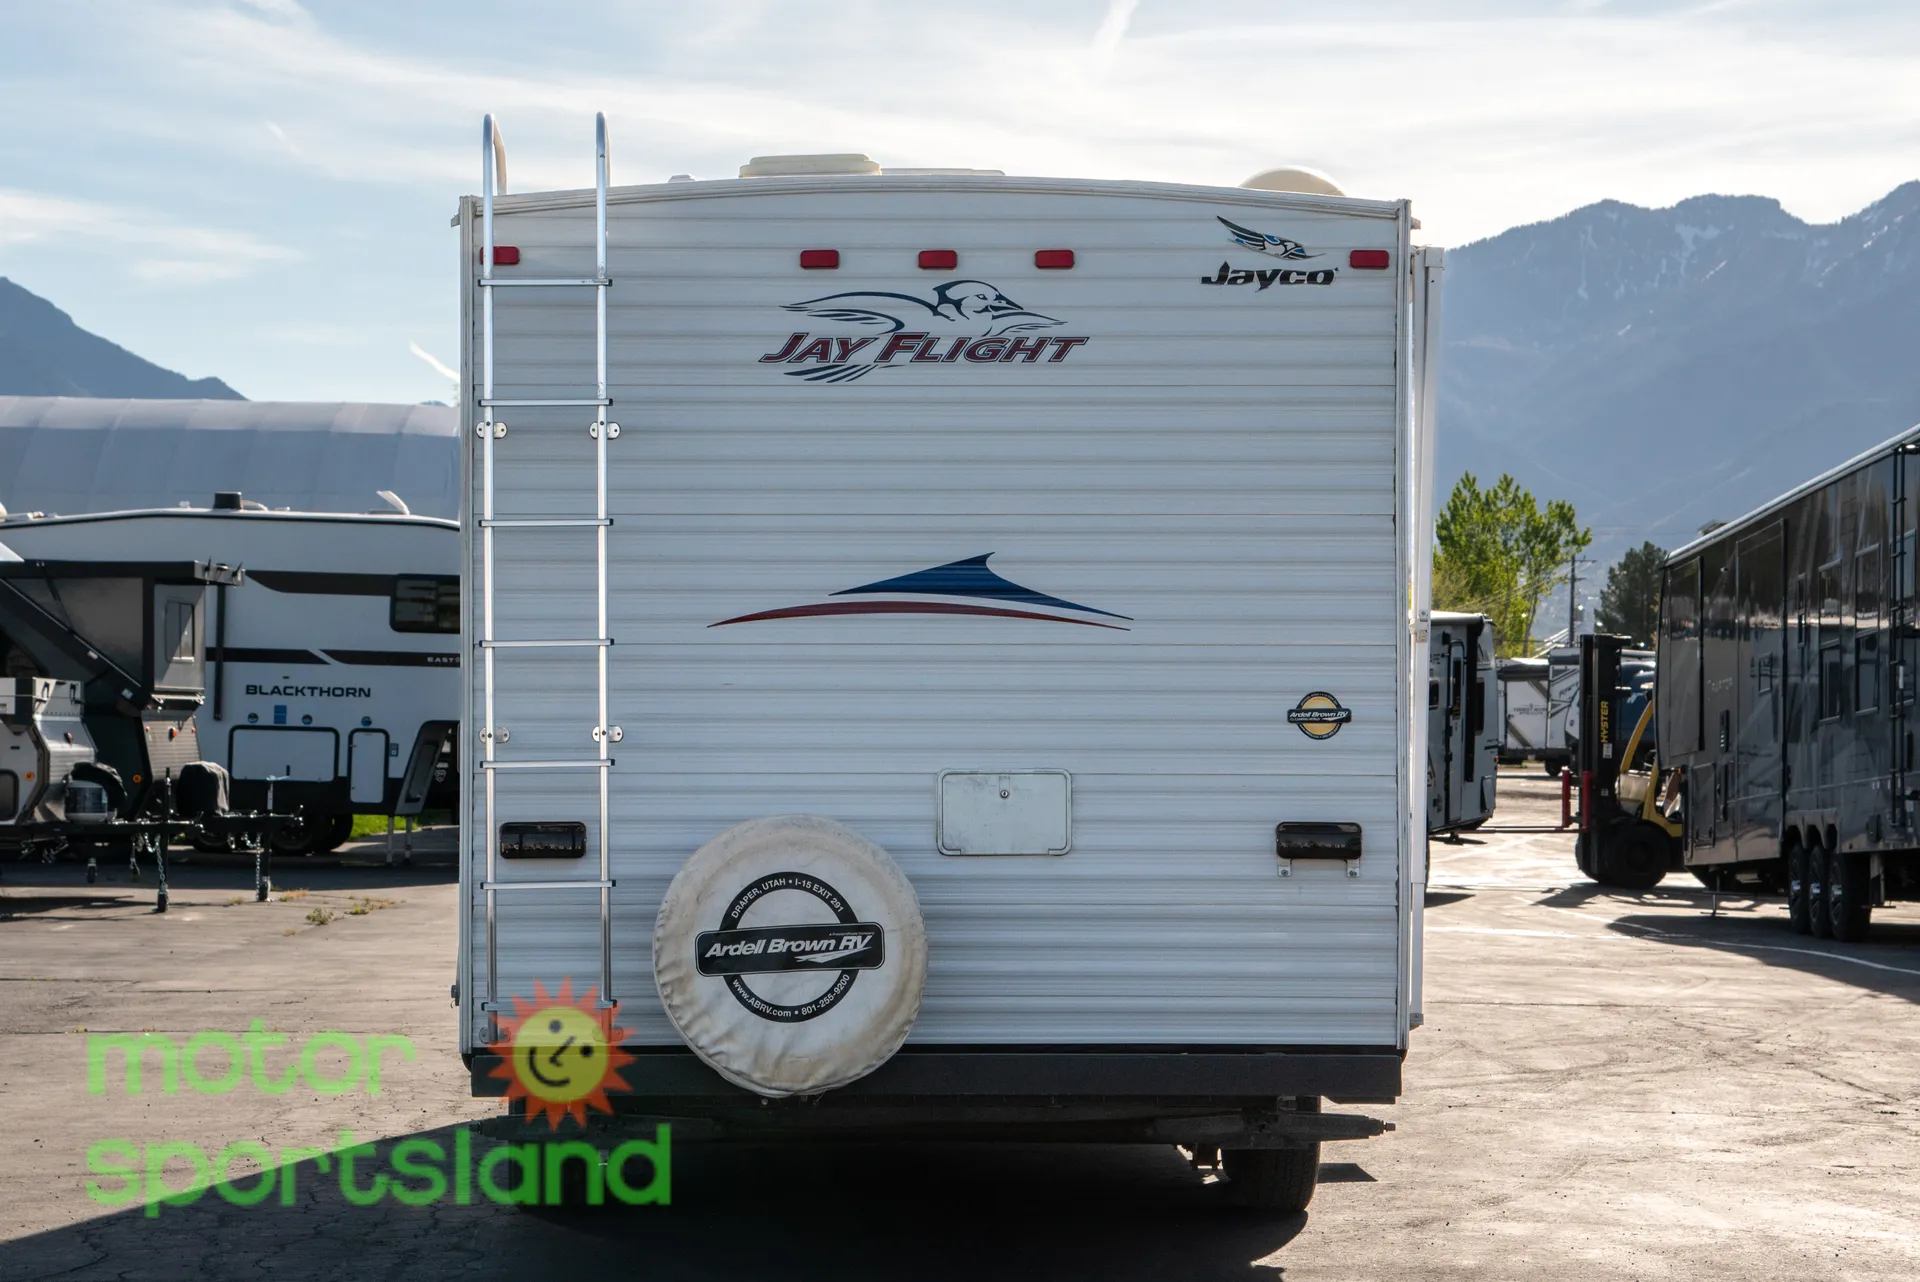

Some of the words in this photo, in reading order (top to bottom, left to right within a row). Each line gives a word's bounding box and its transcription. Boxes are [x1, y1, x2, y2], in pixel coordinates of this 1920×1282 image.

[1201, 260, 1335, 293] Jayco
[758, 332, 880, 363] JAY
[873, 331, 1090, 363] FLIGHT
[245, 684, 371, 698] BLACKTHORN
[1600, 700, 1609, 743] HYSTER
[731, 887, 763, 919] DRAPER,
[761, 878, 786, 891] UTAH
[795, 878, 812, 889] I-15
[812, 884, 832, 900] EXIT
[830, 897, 845, 913] 291
[704, 938, 766, 958] Ardell
[767, 935, 836, 954] Brown
[838, 934, 873, 951] RV
[732, 978, 792, 1018] www.ABRV.com
[801, 973, 850, 1016] 801-255-9200
